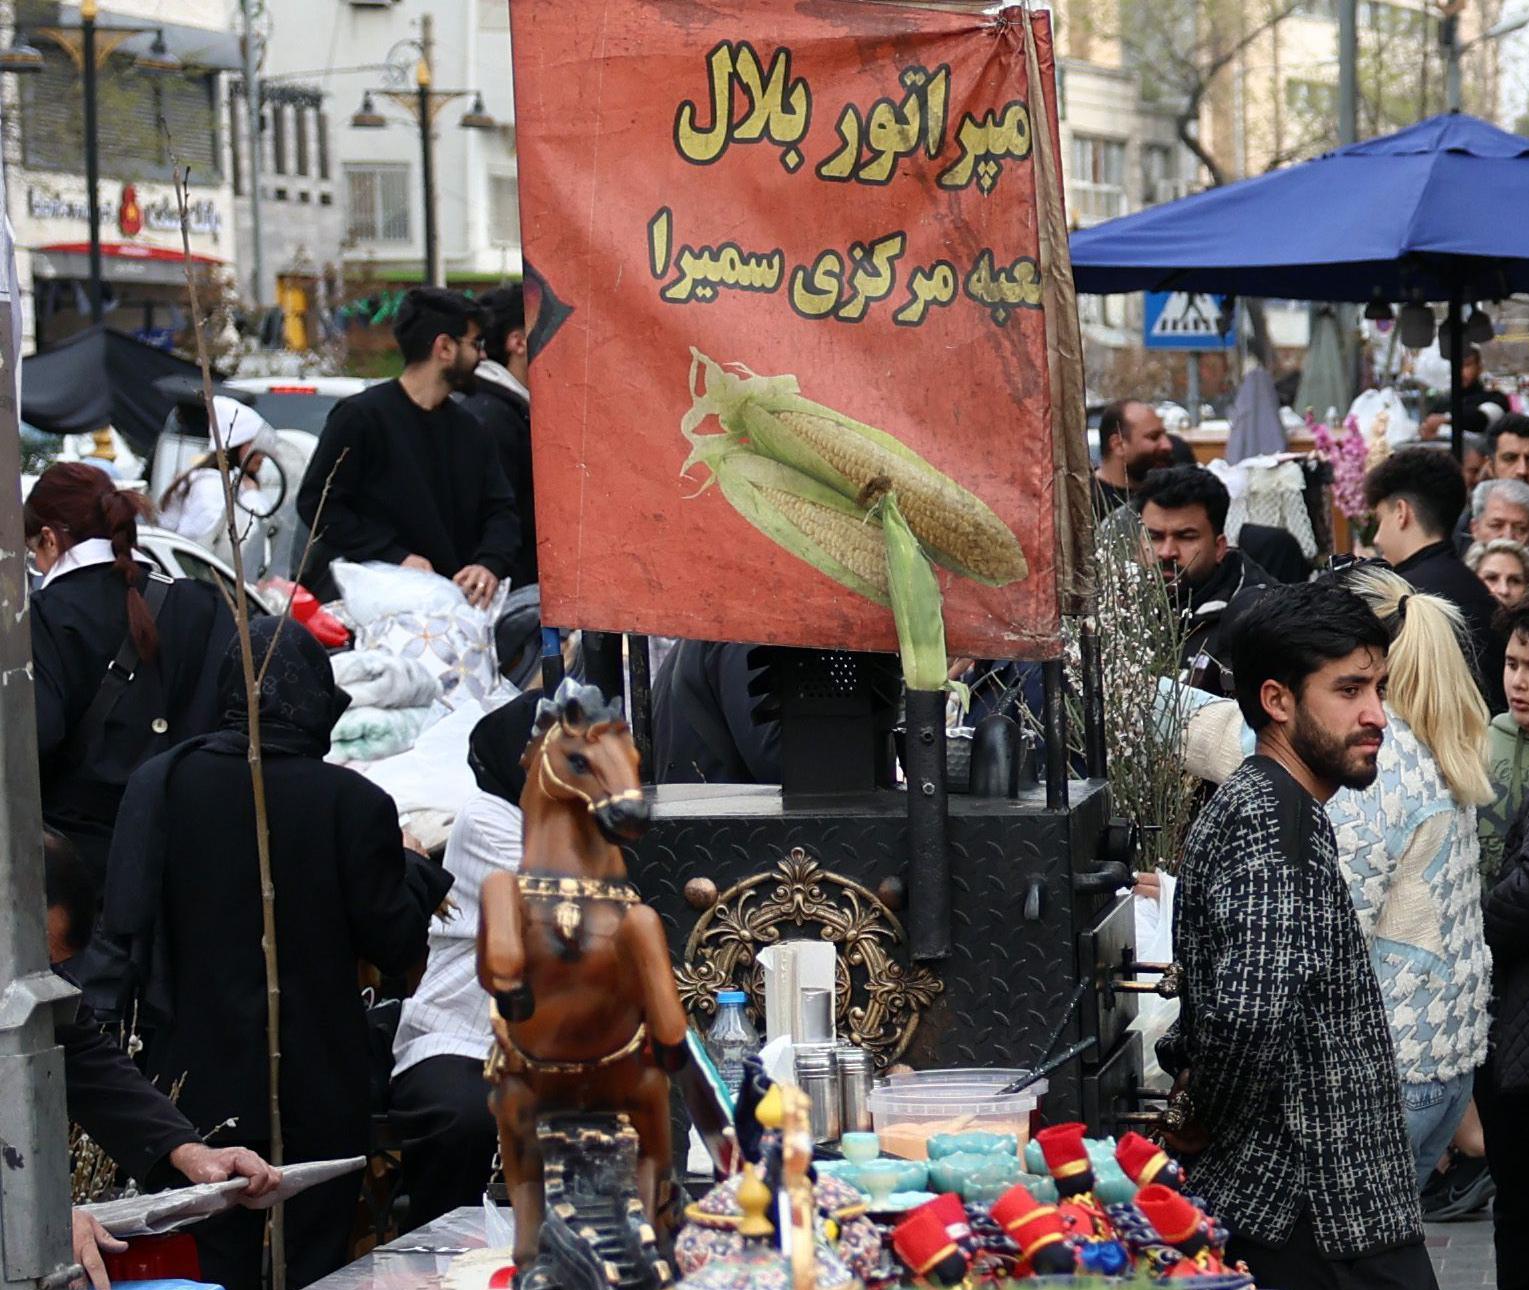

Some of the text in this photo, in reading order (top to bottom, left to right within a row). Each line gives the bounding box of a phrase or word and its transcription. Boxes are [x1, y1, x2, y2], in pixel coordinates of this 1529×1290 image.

[674, 39, 1032, 195] مپراتور بلال
[646, 205, 1044, 327] عبه مرکزی سمیرا
